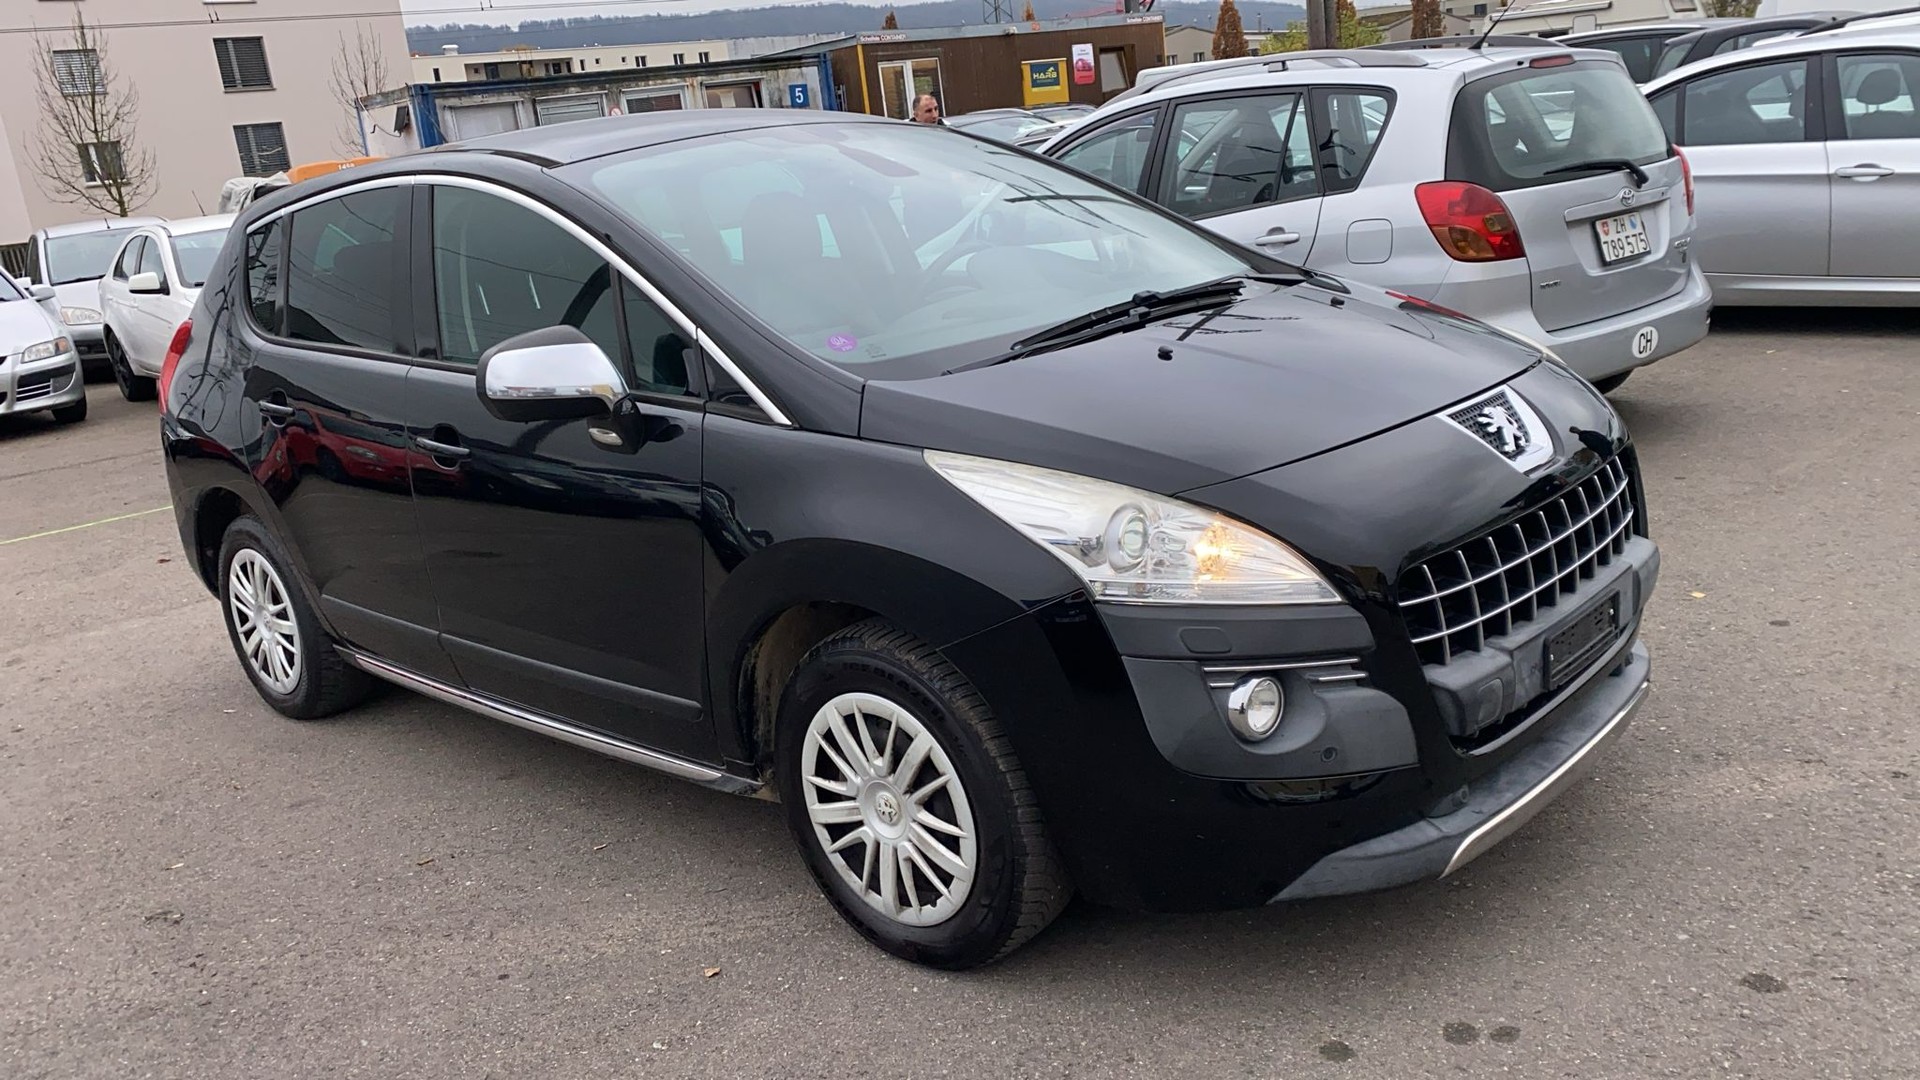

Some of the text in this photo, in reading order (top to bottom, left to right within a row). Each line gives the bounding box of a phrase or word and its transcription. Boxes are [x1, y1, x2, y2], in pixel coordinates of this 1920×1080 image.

[1033, 71, 1058, 80] HARB
[795, 87, 804, 104] 5
[1613, 217, 1627, 234] ZH
[1638, 329, 1653, 355] CH
